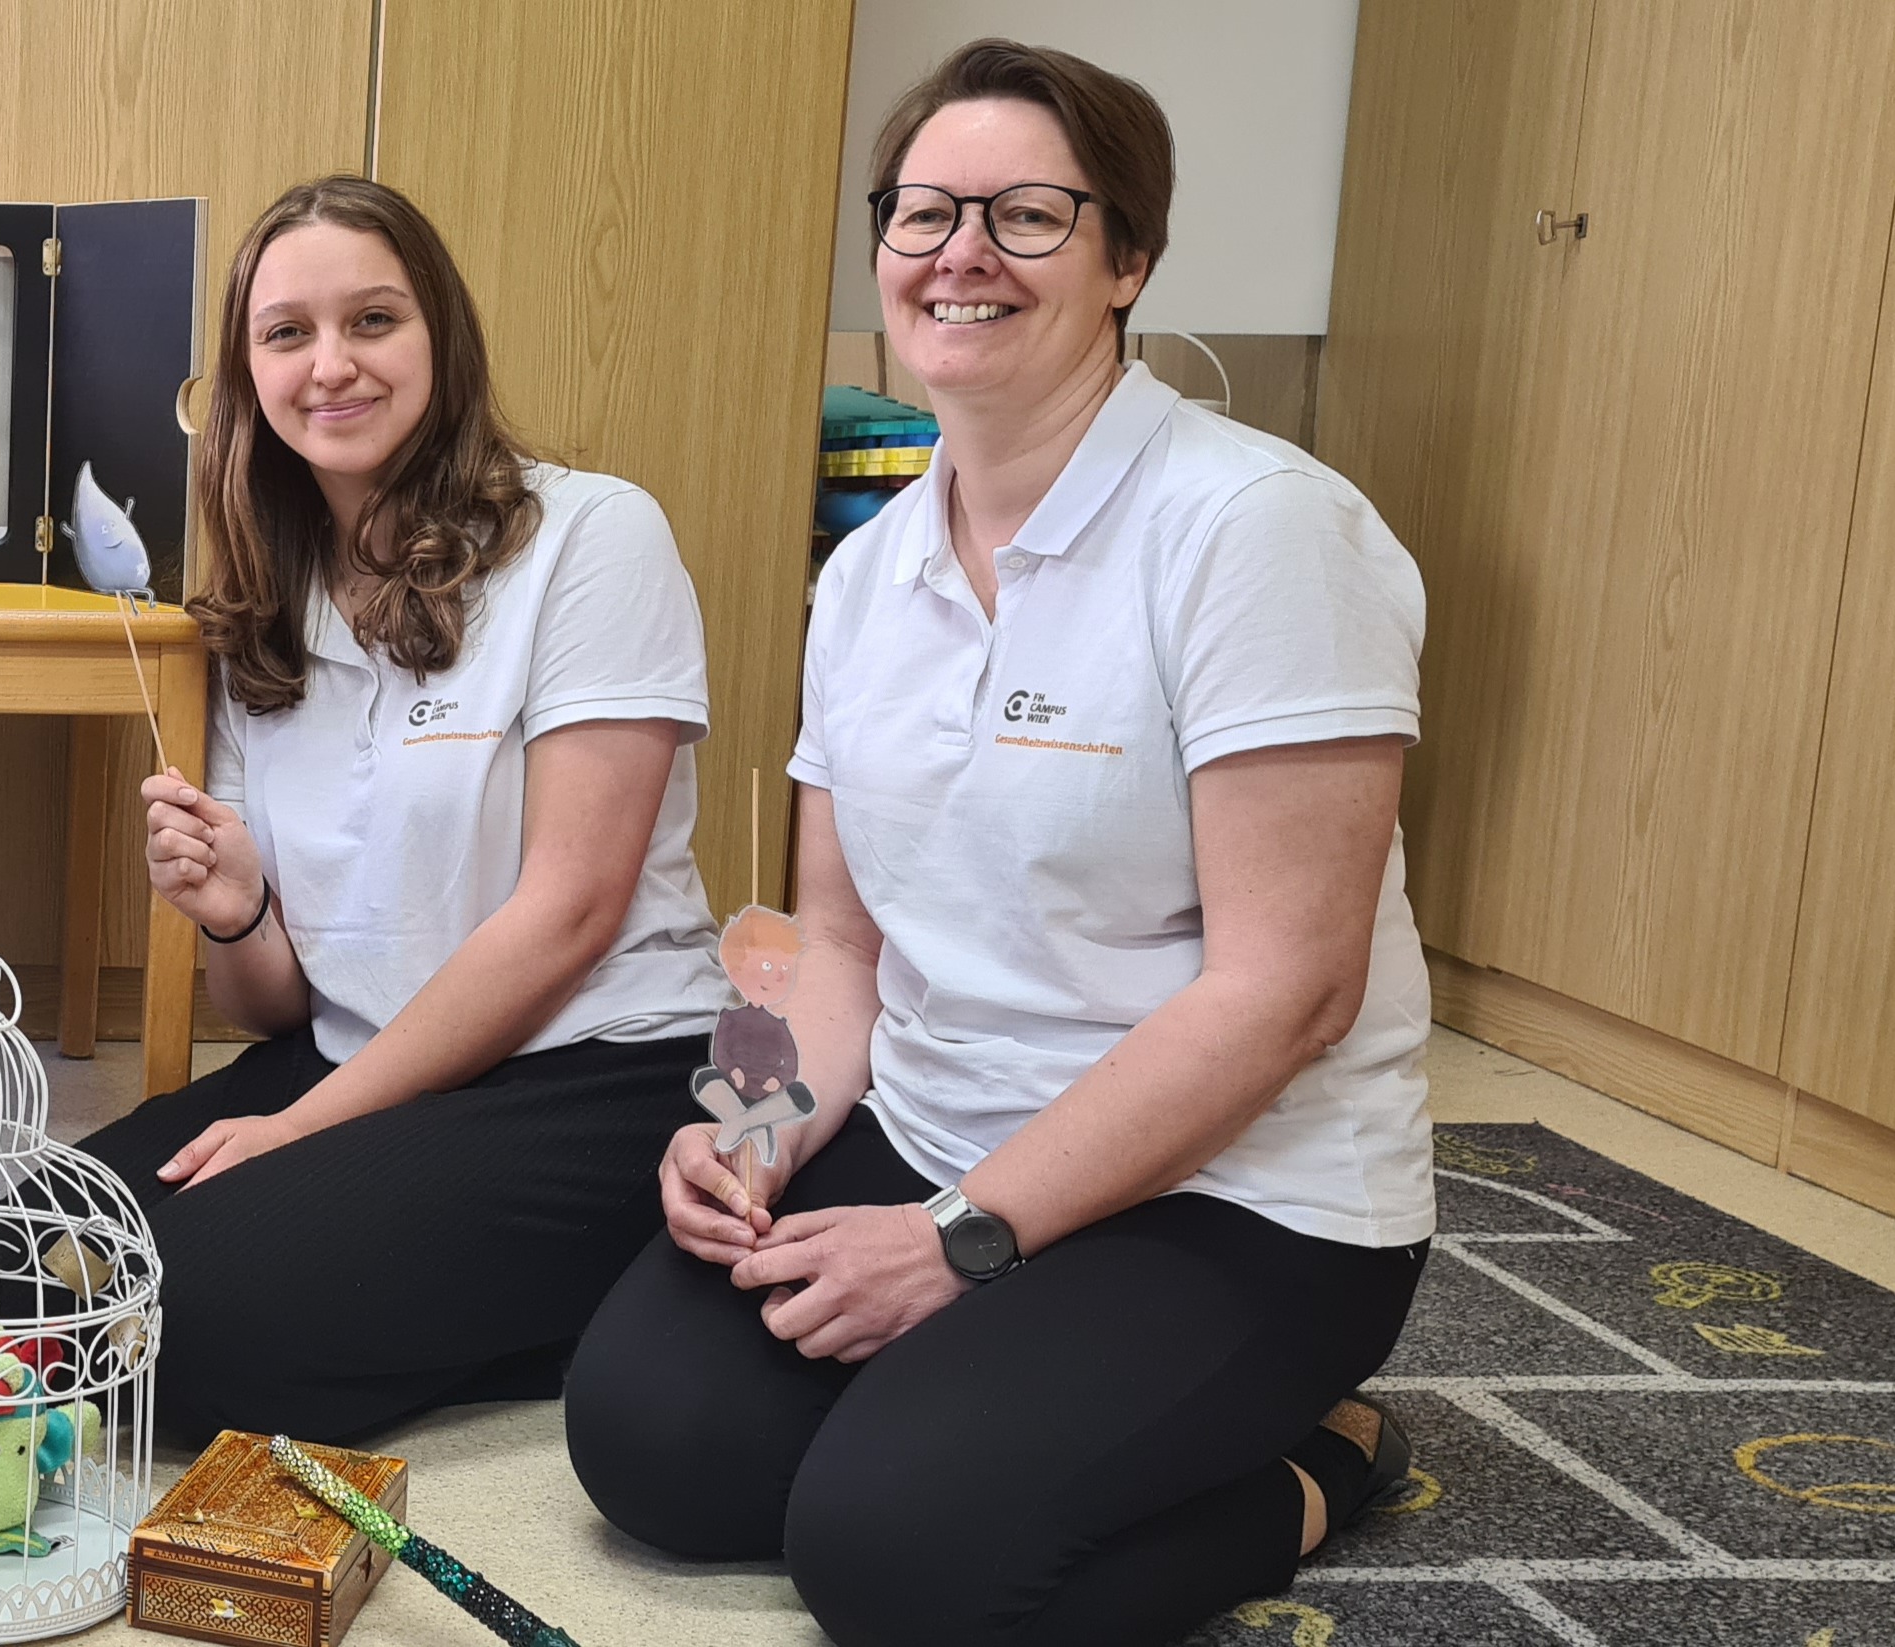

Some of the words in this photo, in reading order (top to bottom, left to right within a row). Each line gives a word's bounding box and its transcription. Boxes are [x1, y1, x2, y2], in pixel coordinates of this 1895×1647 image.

[1033, 693, 1046, 702] FH
[432, 701, 459, 713] CAMPUS
[1030, 703, 1067, 715] CAMPUS
[1027, 713, 1051, 724] WIEN
[995, 733, 1123, 755] Gesundheitswissenschaften
